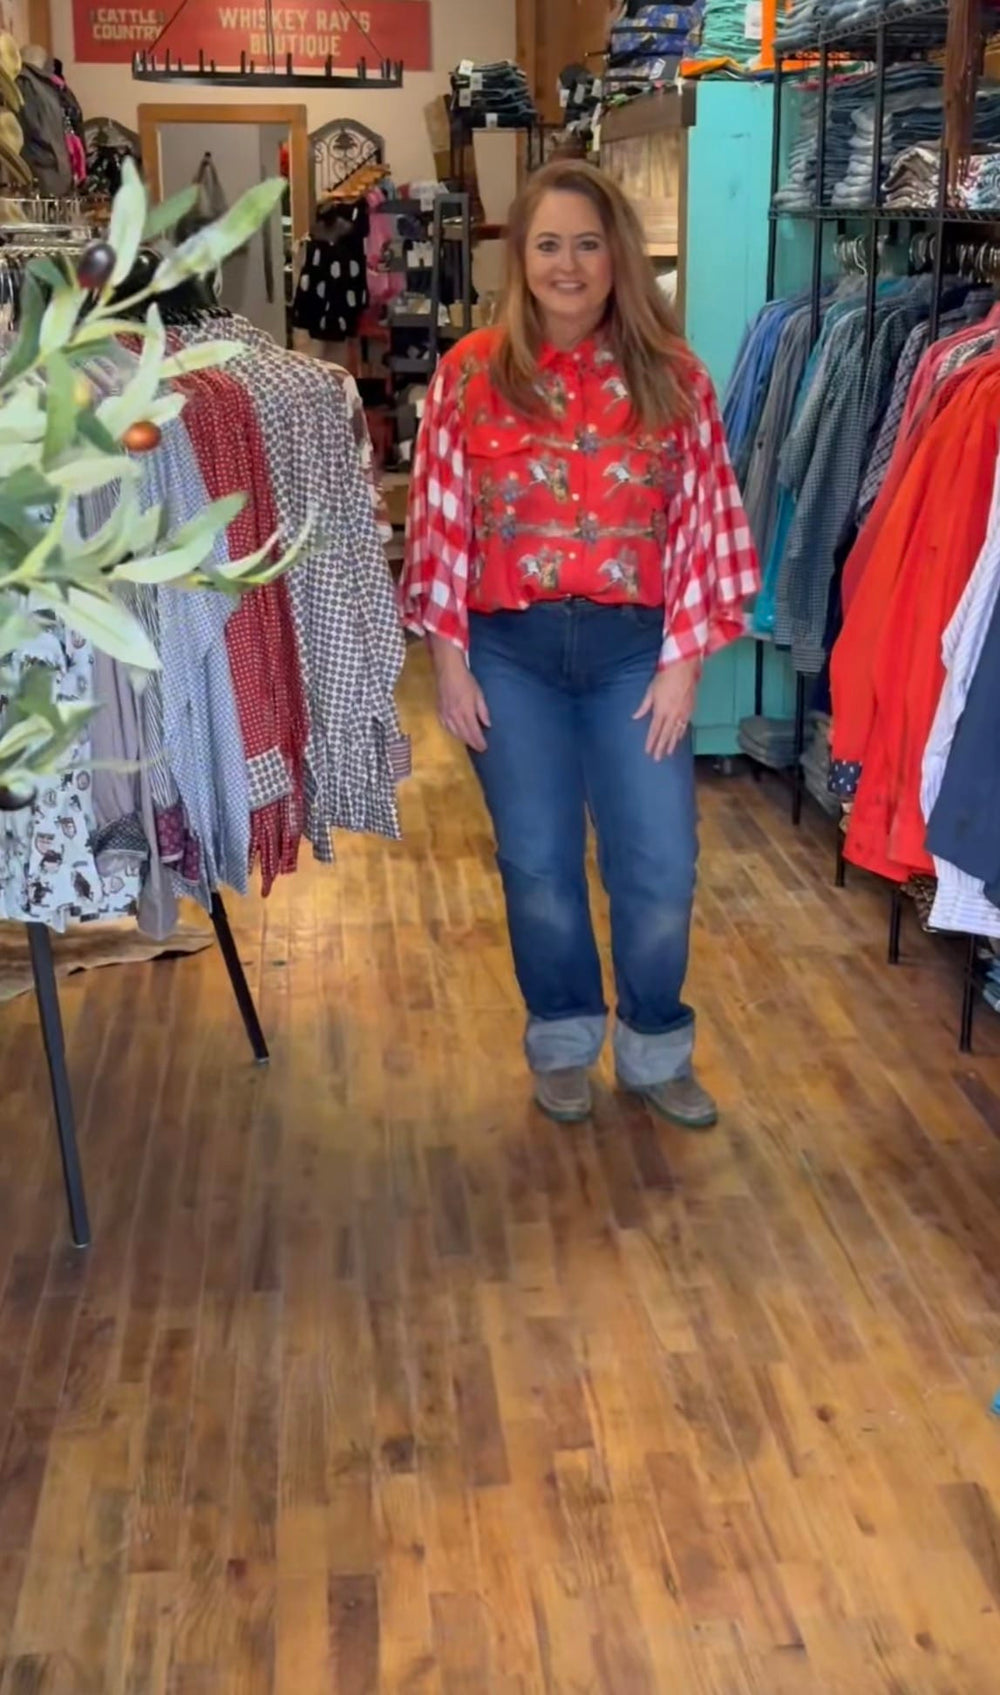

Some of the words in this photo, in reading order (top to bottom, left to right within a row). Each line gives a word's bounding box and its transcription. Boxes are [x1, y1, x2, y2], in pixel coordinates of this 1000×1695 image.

[97, 8, 157, 24] CATTLE
[218, 7, 307, 30] WHISKEY
[93, 24, 164, 40] COUNTRY
[250, 33, 341, 58] BOUTIQUE
